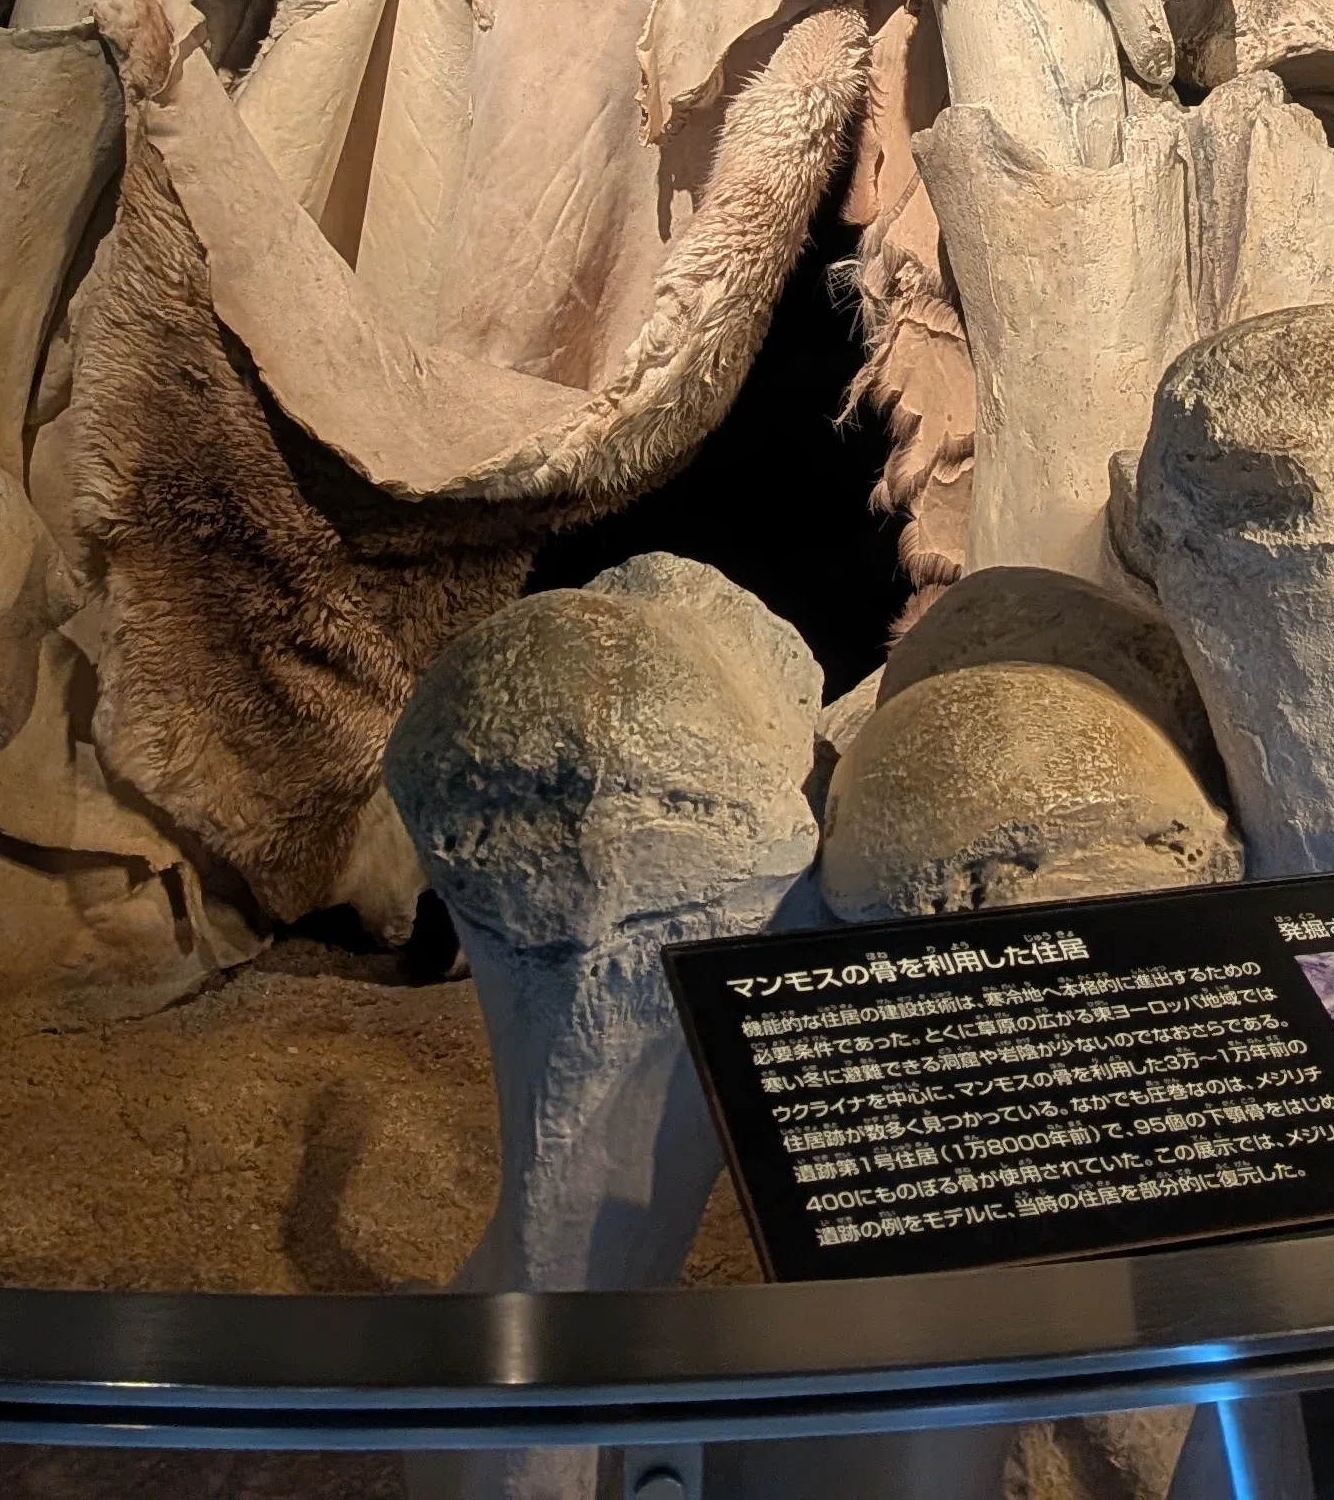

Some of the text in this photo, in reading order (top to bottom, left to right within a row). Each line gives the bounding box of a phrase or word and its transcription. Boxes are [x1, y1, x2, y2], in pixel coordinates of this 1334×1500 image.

[727, 938, 1089, 997] マンモスの骨を利用した住居
[754, 987, 1277, 1065] 必要条件であった。とくに草原の広がる東ヨーロッパ地域では
[816, 1163, 1305, 1246] 遺跡の例をモデルに、当時の住居を部分的に復元した。
